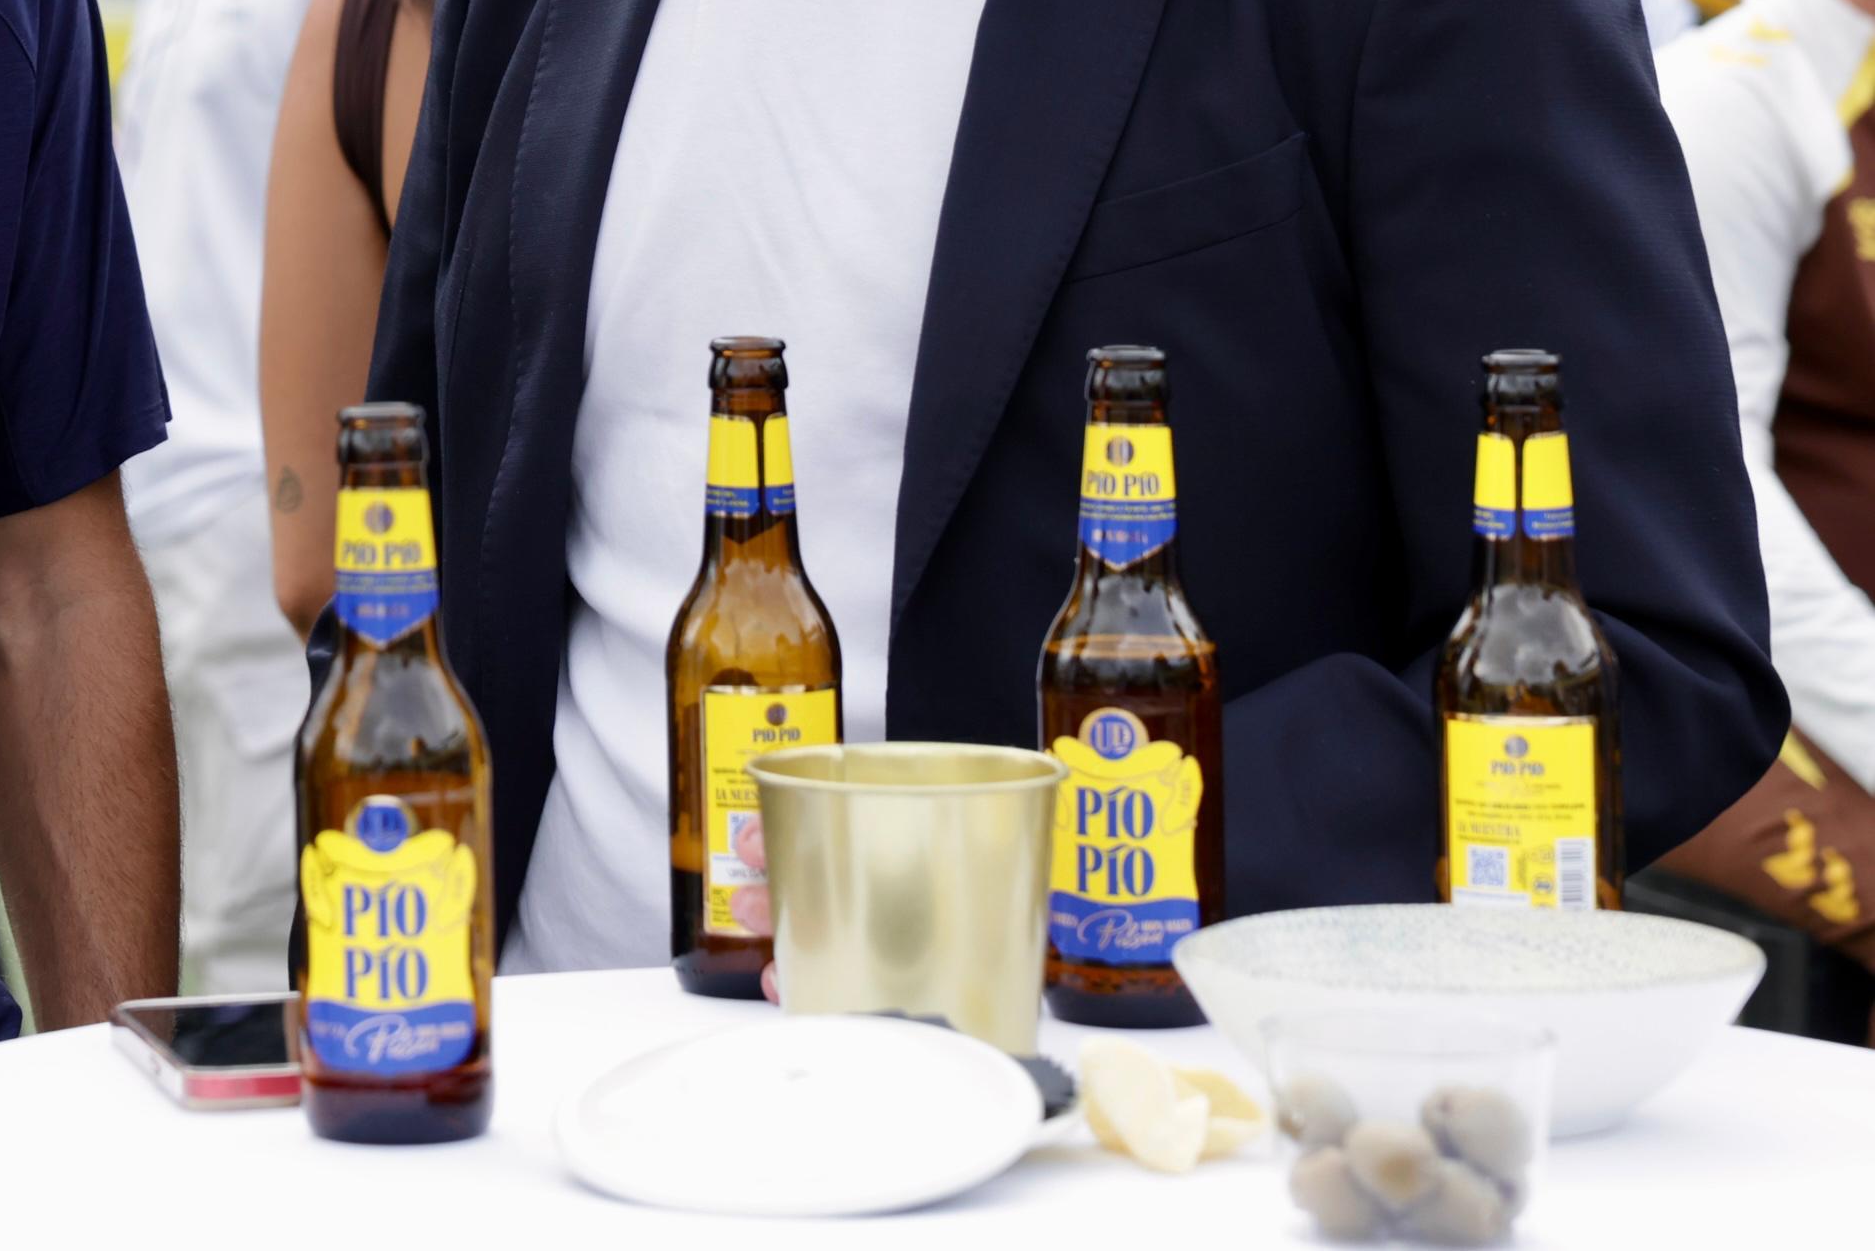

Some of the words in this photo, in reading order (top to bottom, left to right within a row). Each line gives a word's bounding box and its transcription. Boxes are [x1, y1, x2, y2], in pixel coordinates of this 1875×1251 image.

[1076, 785, 1155, 838] PÍO
[1077, 842, 1155, 897] PÍO
[343, 880, 427, 938] PÍO
[344, 944, 429, 1001] PÍO
